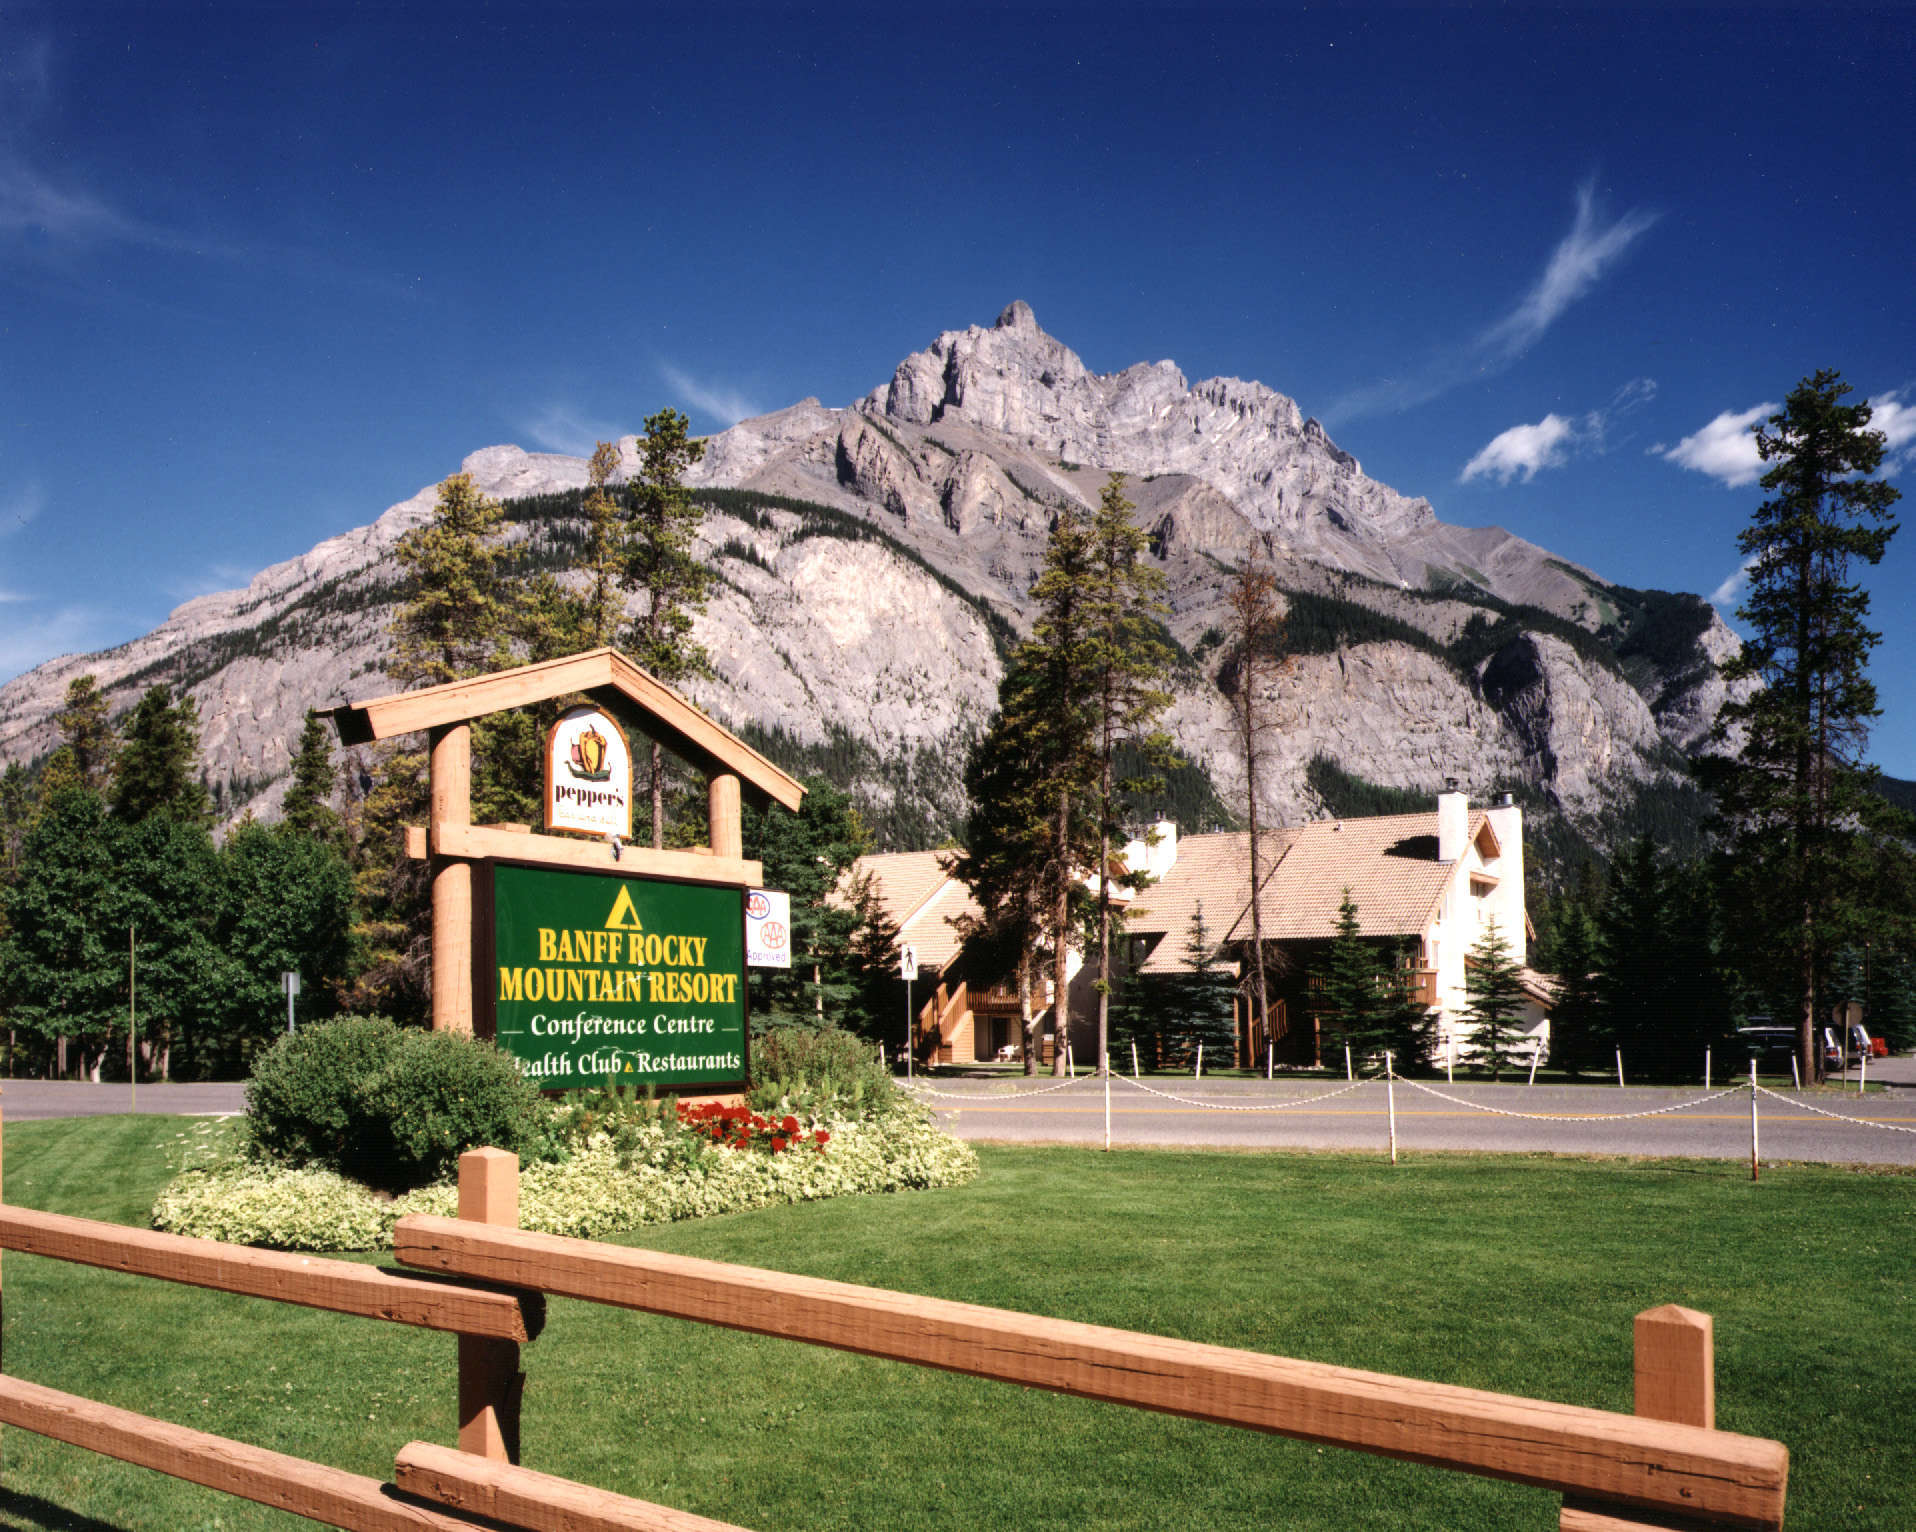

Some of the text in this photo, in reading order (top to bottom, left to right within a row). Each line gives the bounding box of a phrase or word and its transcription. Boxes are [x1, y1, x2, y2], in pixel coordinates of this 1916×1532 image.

[538, 928, 707, 967] BANFF ROCKY
[763, 923, 784, 948] AAA
[499, 967, 738, 1003] MOUNTAIN RESORT
[531, 1012, 715, 1044] Conference Centre
[578, 1050, 622, 1075] Club
[637, 1051, 741, 1074] Restaurants
